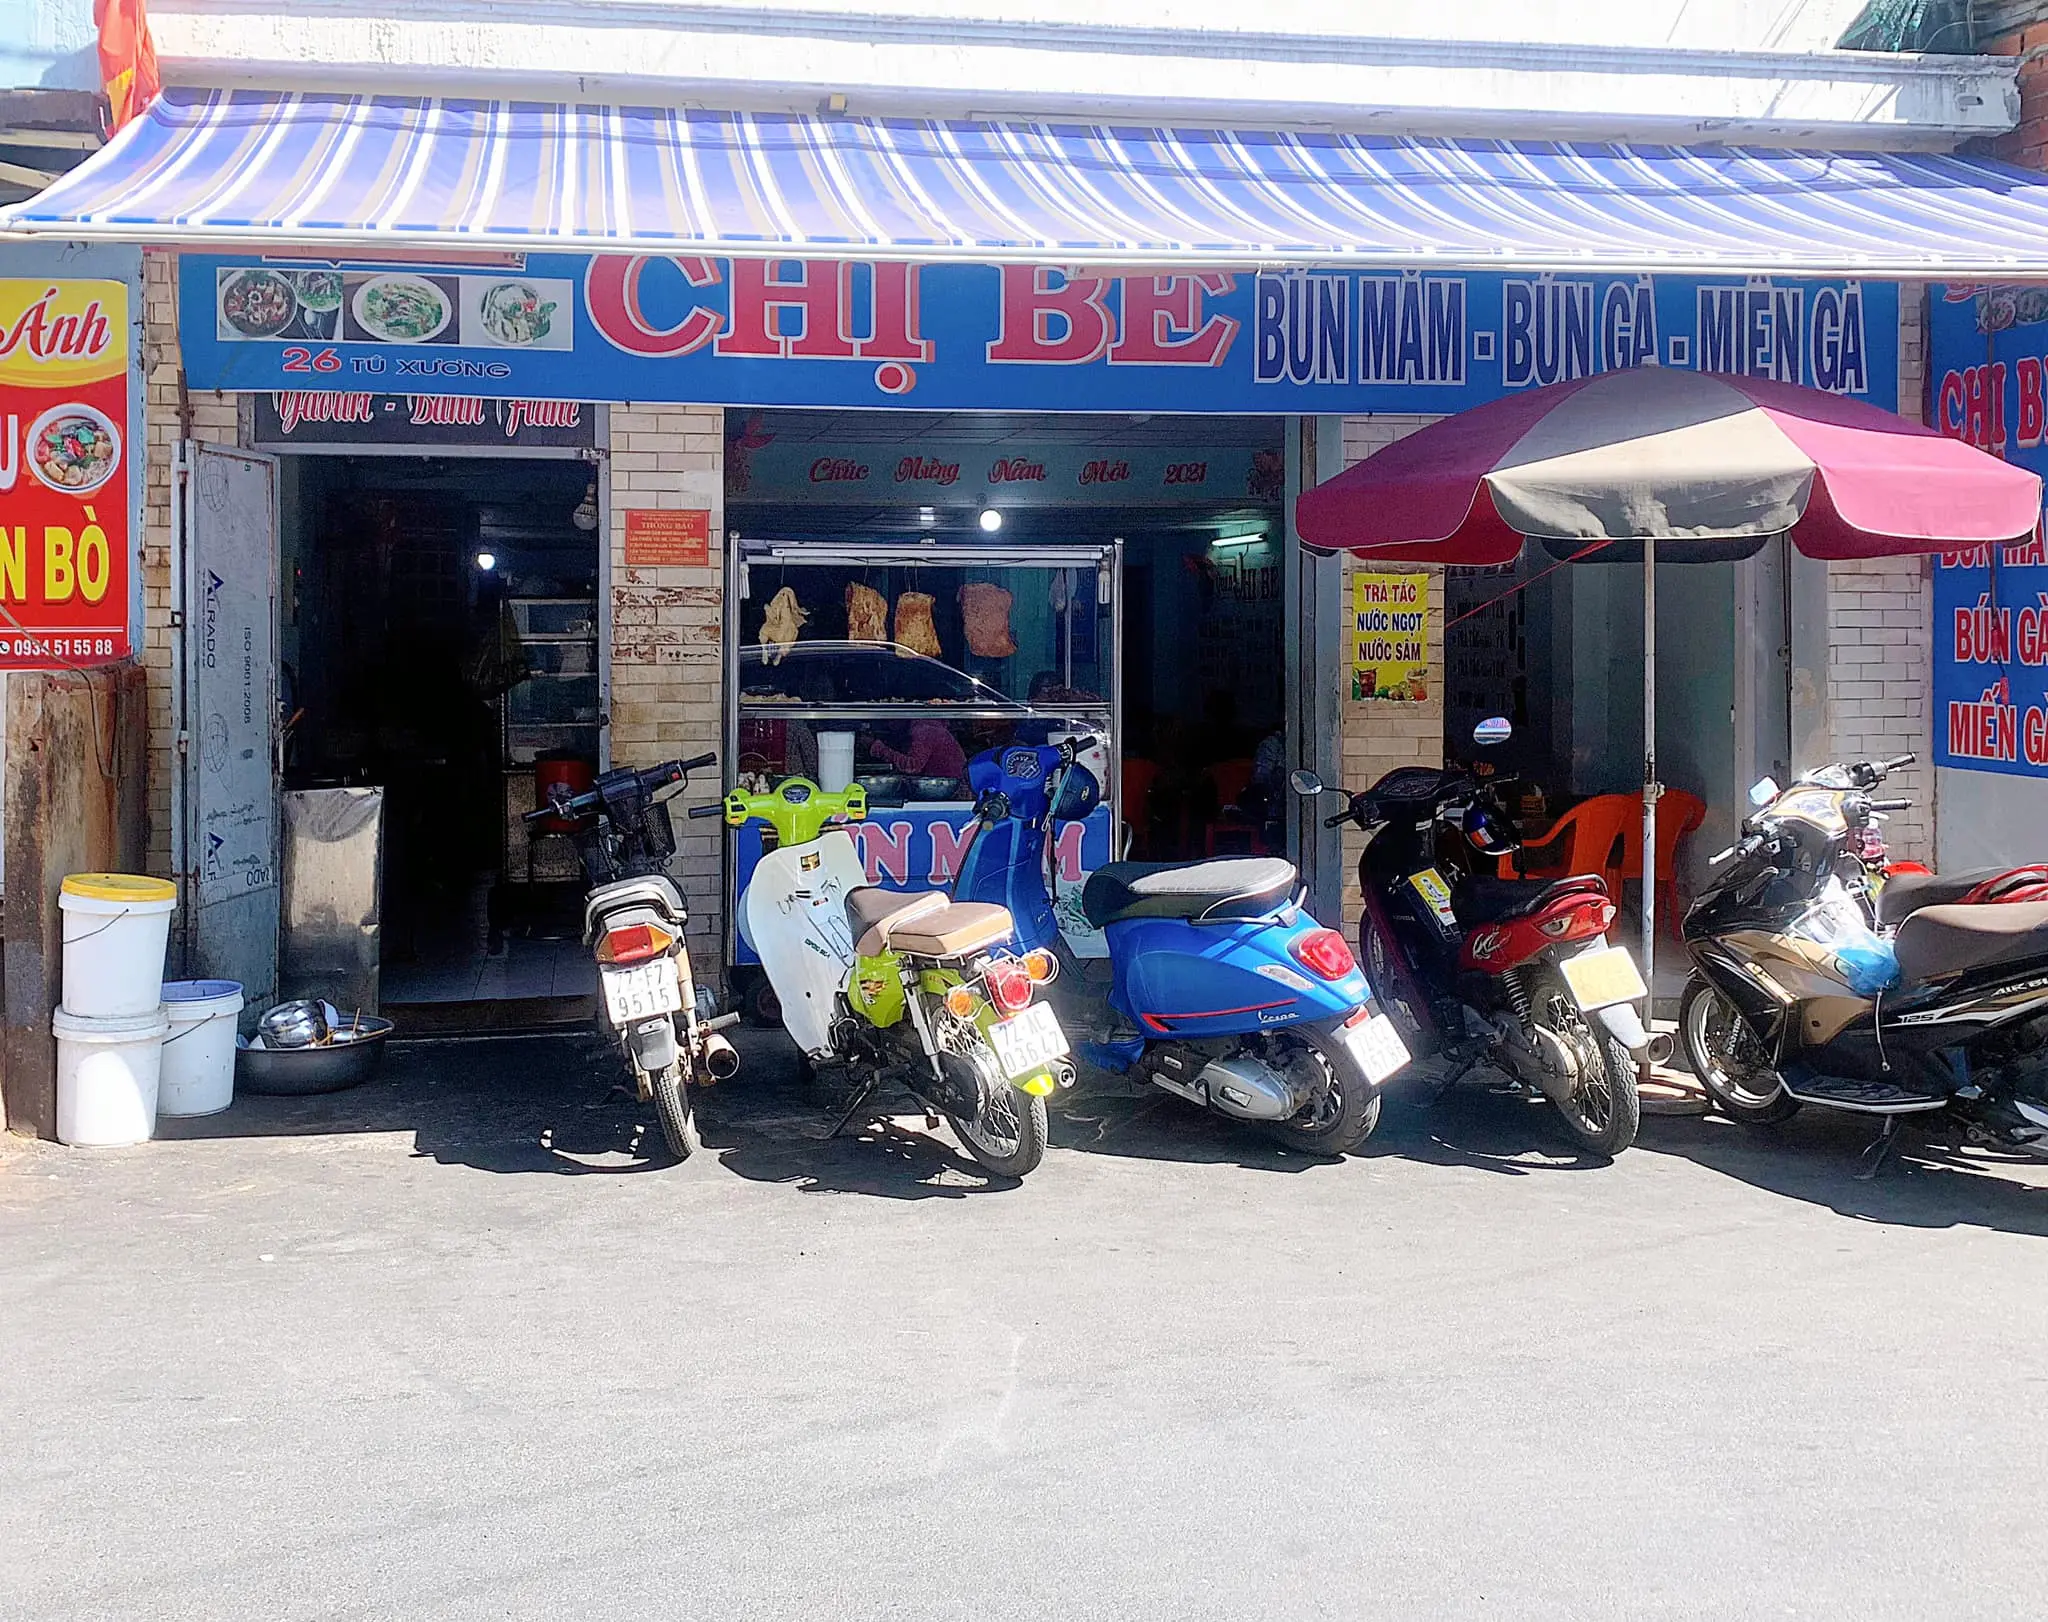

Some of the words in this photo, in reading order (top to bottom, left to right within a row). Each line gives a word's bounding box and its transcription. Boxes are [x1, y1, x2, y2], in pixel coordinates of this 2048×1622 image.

[282, 347, 342, 372] 26
[396, 359, 511, 378] XƯƠNG
[2016, 356, 2048, 448] B
[1164, 461, 1208, 485] 2021
[44, 504, 110, 602] BÒ
[1363, 579, 1389, 603] TRÀ
[1391, 577, 1417, 603] TẮC
[1356, 607, 1389, 632] NƯỚC
[1391, 612, 1424, 637] NGỌT
[1955, 591, 2011, 665] BÚN
[14, 639, 50, 656] 0934
[54, 639, 70, 656] 51
[73, 639, 91, 656] 55
[95, 639, 113, 656] 88
[243, 626, 252, 652] ISO
[1358, 636, 1393, 661] NƯỚC
[1395, 638, 1421, 661] SÂM
[1948, 682, 2018, 763] MIẾN
[618, 987, 670, 1018] 9515
[1902, 1013, 1936, 1024] 125
